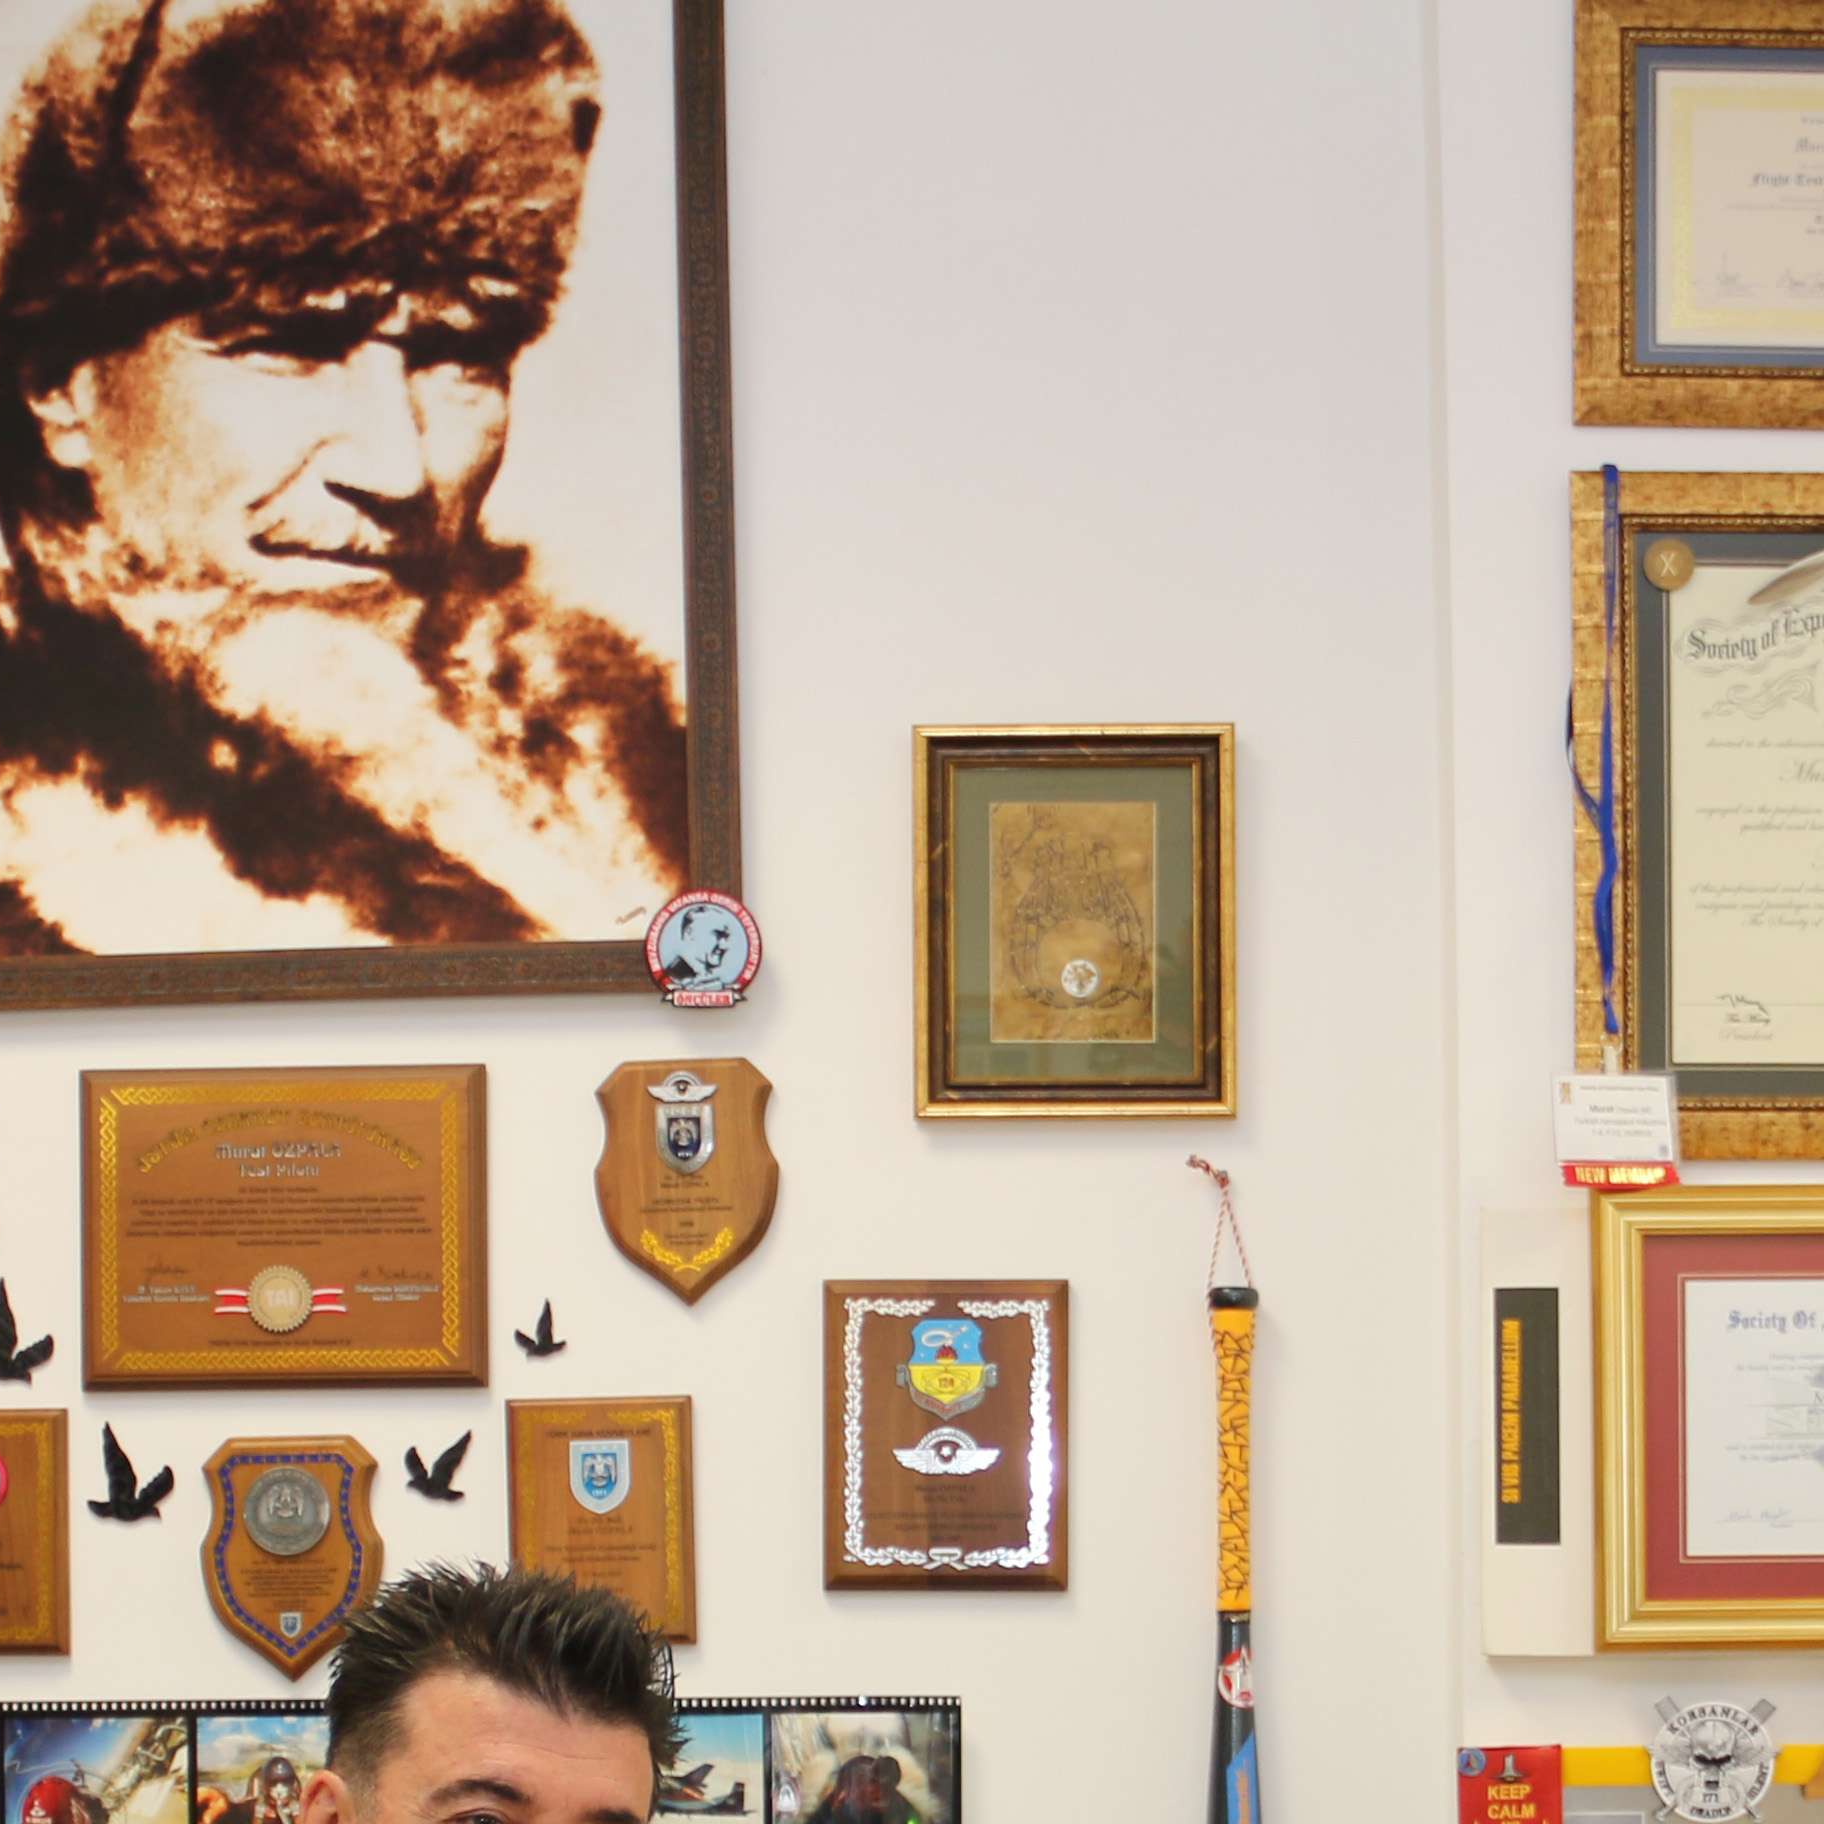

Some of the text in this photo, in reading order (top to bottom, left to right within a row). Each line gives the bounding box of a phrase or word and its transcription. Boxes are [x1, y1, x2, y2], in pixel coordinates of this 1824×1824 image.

[1687, 628, 1758, 662] Society
[1727, 1310, 1788, 1334] Society
[1792, 1310, 1816, 1329] Of
[1500, 1319, 1522, 1411] PARABELLUM
[1500, 1412, 1522, 1461] PACEM
[1666, 1704, 1760, 1737] KORSANLAR
[1487, 1784, 1531, 1801] KEEP
[1487, 1803, 1537, 1820] CALM
